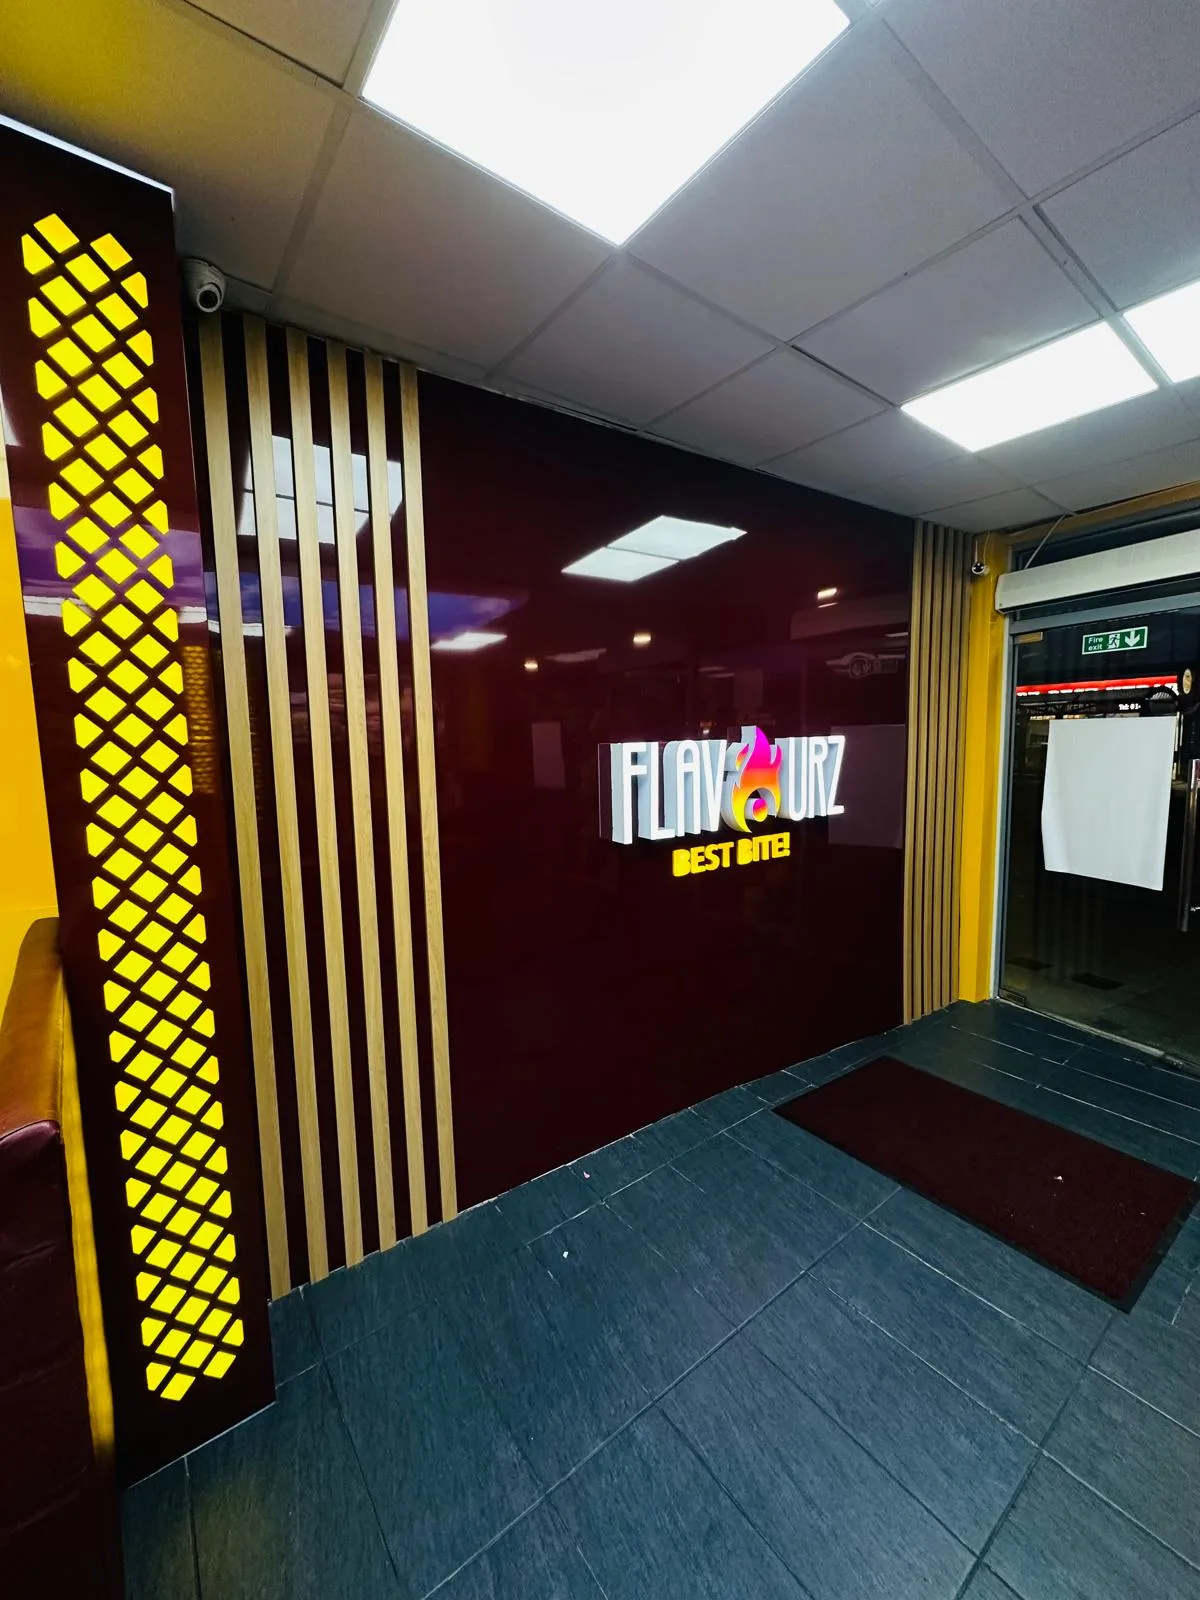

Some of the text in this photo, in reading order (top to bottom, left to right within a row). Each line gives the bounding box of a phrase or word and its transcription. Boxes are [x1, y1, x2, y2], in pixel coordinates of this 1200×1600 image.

[1088, 636, 1104, 644] Fire
[672, 832, 791, 877] BEST BITE!
